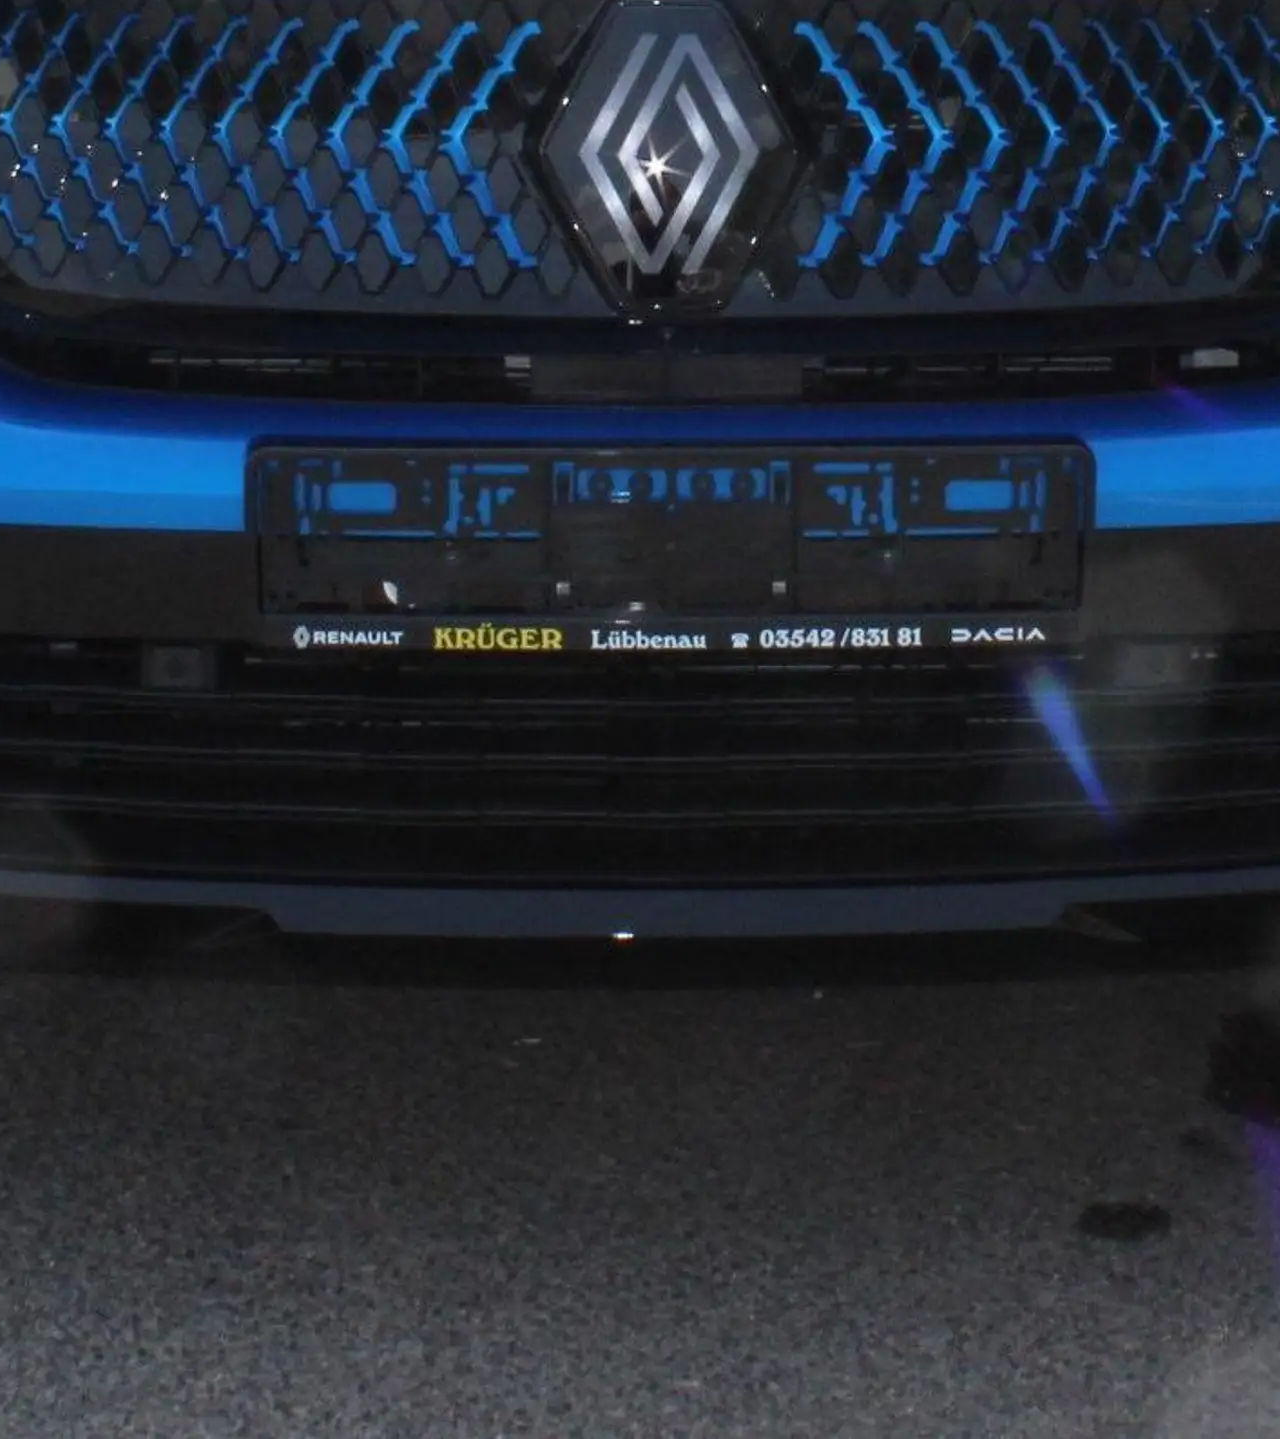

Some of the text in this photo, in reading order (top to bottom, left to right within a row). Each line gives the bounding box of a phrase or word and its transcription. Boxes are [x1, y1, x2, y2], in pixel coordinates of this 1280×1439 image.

[313, 630, 403, 645] RENAULT
[433, 623, 563, 650] KRÜGER
[590, 629, 707, 651] Lübbenau
[759, 628, 835, 648] 03542
[950, 627, 1046, 642] DACIA
